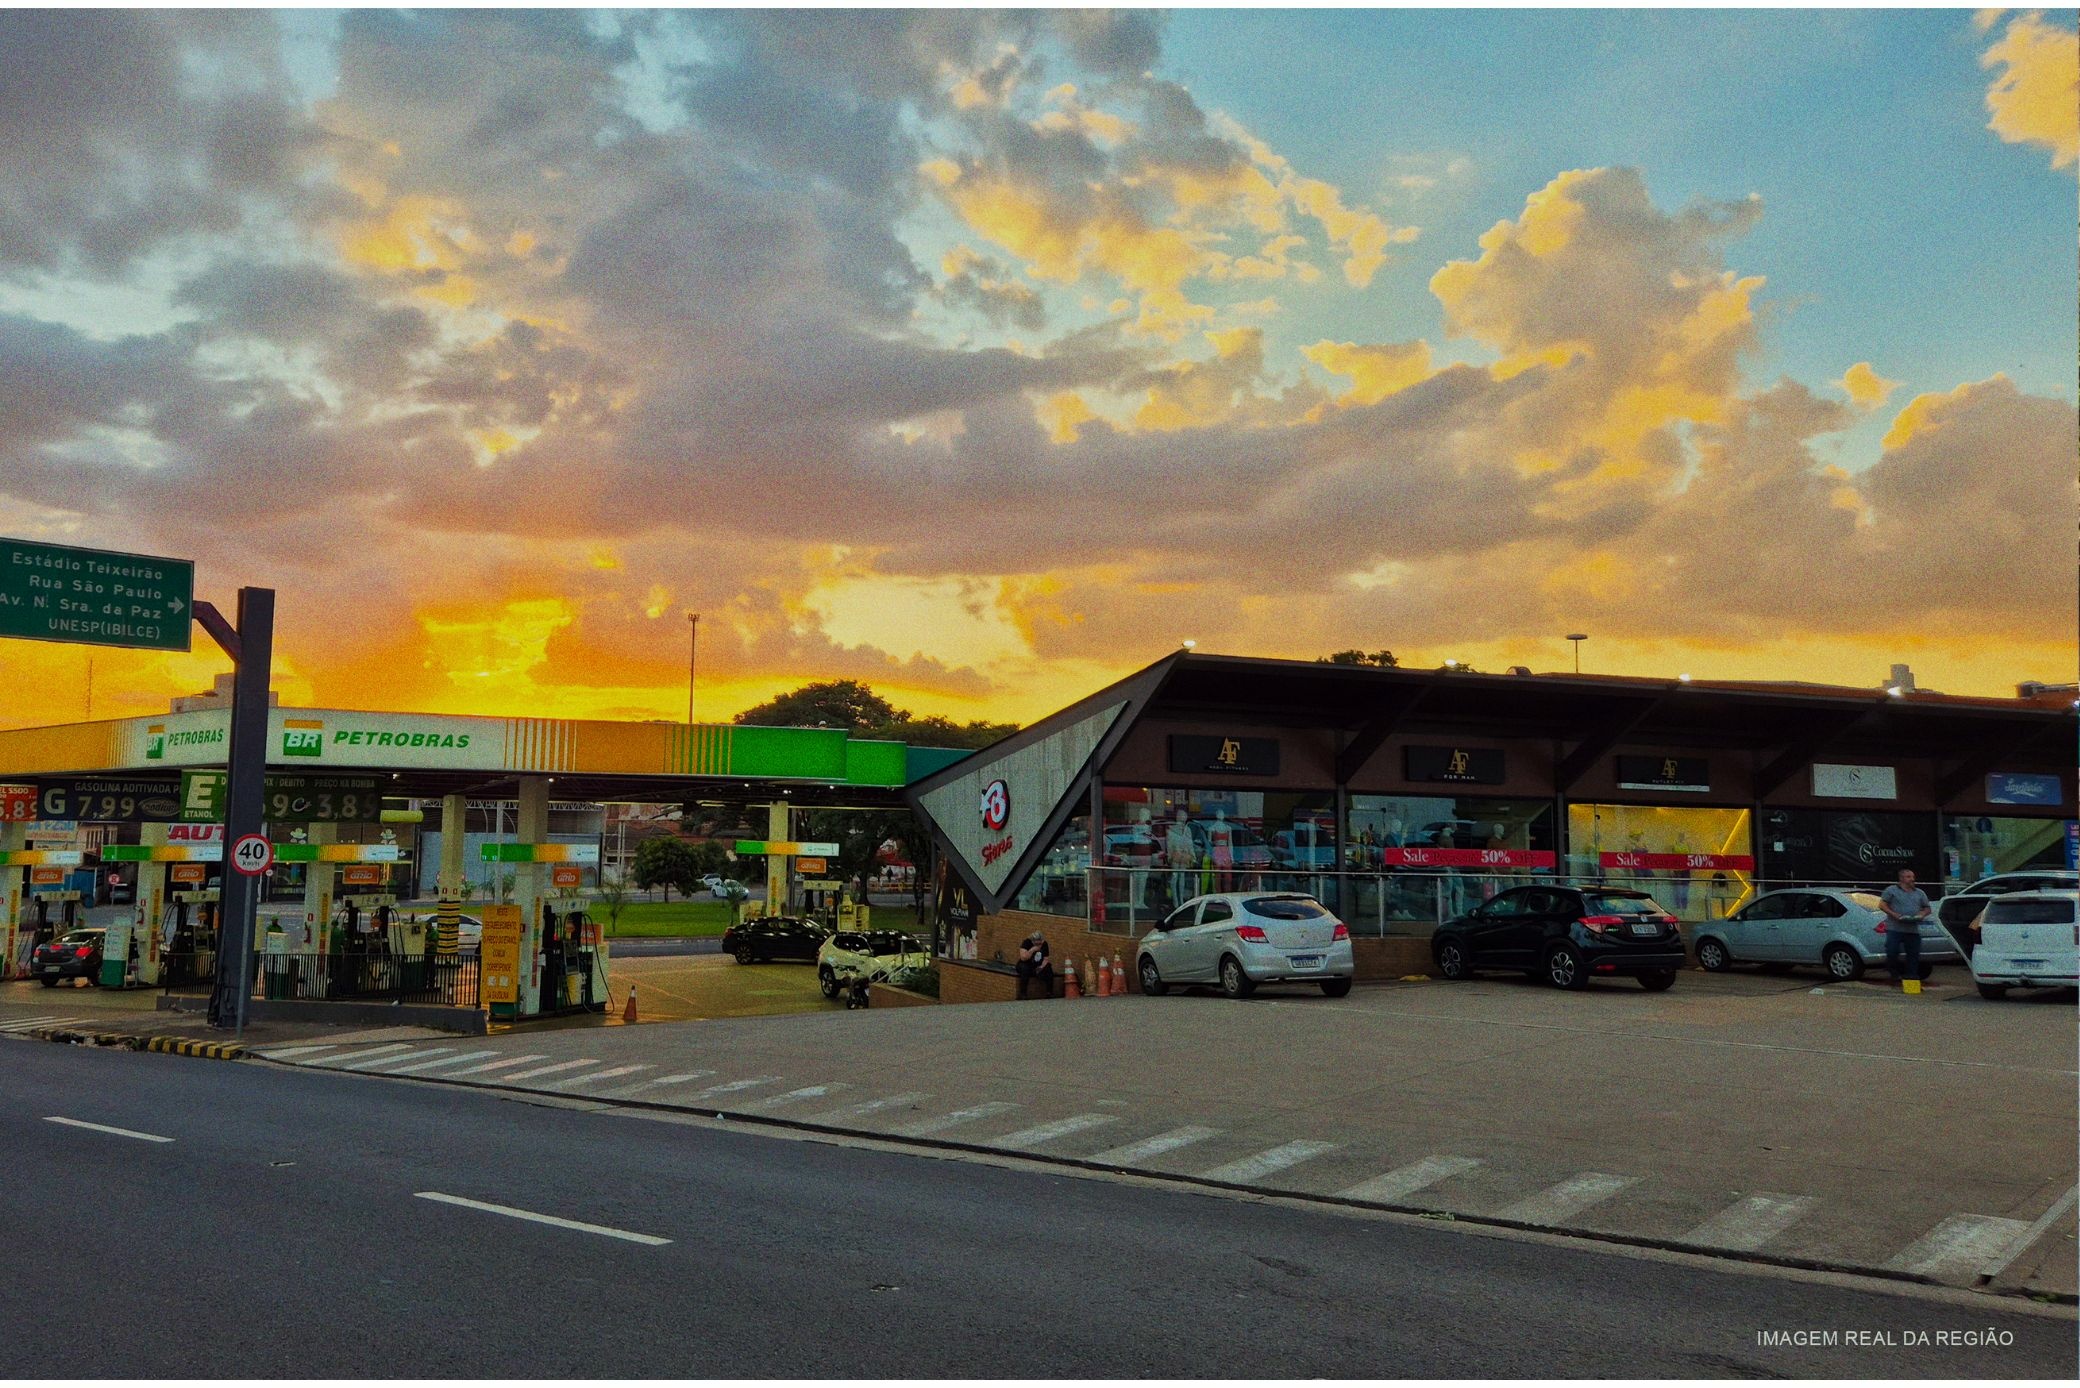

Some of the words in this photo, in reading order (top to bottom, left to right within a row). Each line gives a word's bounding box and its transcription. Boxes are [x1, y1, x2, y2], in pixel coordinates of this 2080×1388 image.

[12, 552, 81, 571] Estádio
[86, 560, 163, 580] Teixeirão
[29, 575, 62, 589] Rua
[73, 580, 104, 593] São
[113, 584, 162, 599] Paulo
[0, 592, 25, 606] Av.
[60, 599, 93, 613] Sra.
[102, 603, 122, 615] da
[131, 605, 161, 619] Paz
[48, 618, 160, 639] UNESP(IBILCE)
[167, 728, 224, 746] PETROBRAS
[285, 732, 319, 748] BR
[332, 730, 470, 749] PETROBRAS
[75, 782, 121, 794] GASOLINA
[122, 783, 172, 795] ADITIVADA
[186, 775, 217, 809] E
[44, 786, 67, 815] G
[77, 796, 136, 818] 7,99
[184, 809, 214, 818] ETANOL
[238, 843, 265, 860] 40
[1402, 847, 1430, 863] Sale
[1480, 849, 1511, 864] 50%
[1616, 852, 1640, 866] Sale
[1686, 854, 1714, 868] 50%
